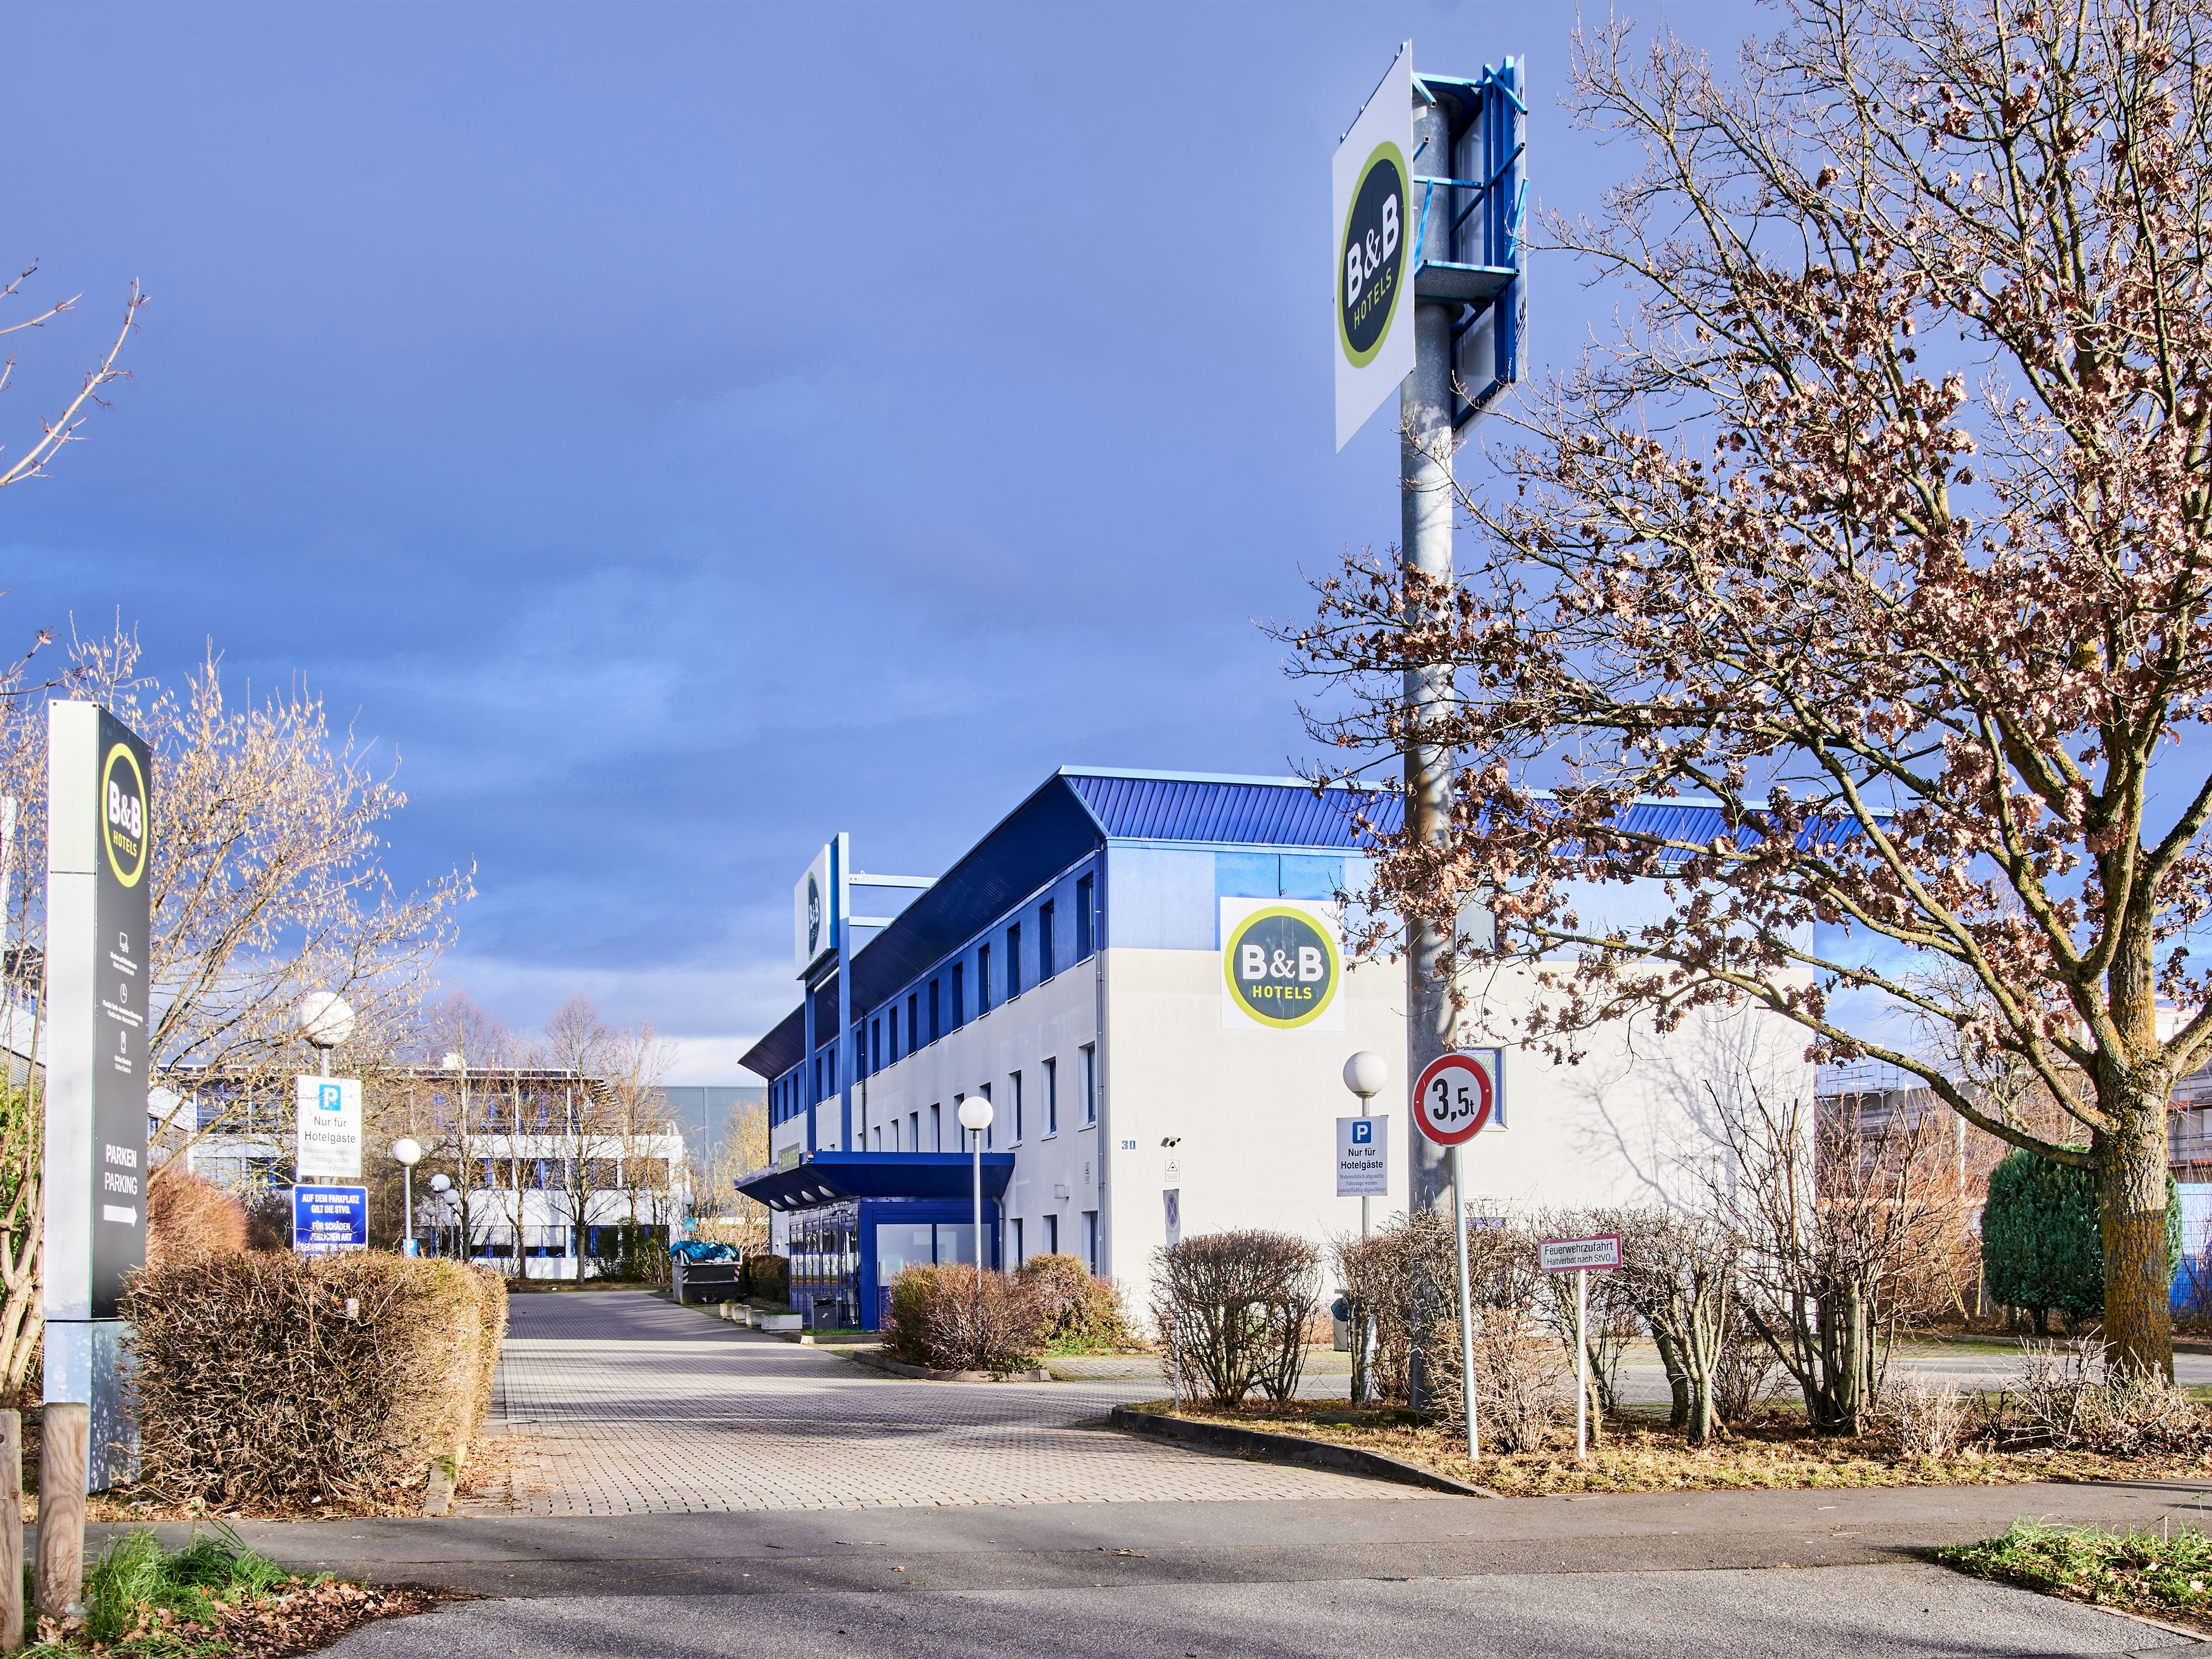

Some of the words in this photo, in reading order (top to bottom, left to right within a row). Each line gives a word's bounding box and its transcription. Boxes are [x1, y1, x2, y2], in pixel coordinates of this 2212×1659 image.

[1348, 194, 1399, 309] B&B
[1354, 268, 1391, 330] HOTELS
[109, 780, 142, 839] B&B
[113, 830, 137, 857] HOTELS
[810, 897, 819, 930] B&B
[1243, 945, 1323, 982] B&B
[1253, 985, 1312, 999] HOTELS
[324, 1087, 338, 1107] P
[314, 1116, 331, 1126] Nur
[334, 1118, 347, 1128] für
[305, 1130, 356, 1144] Hotelgäste
[1357, 1125, 1368, 1140] P
[1121, 1140, 1136, 1150] 30
[1365, 1147, 1376, 1156] für
[106, 1144, 137, 1168] PARKEN
[1341, 1160, 1383, 1170] Hotelgäste
[105, 1172, 137, 1195] PARKING
[302, 1194, 314, 1202] AUF
[315, 1194, 327, 1203] DEM
[328, 1195, 359, 1204] PARKPLATZ
[311, 1204, 324, 1213] GILT
[325, 1205, 334, 1213] DIE
[335, 1206, 351, 1214] STVO.
[312, 1220, 324, 1230] FÜR
[325, 1221, 350, 1231] SCHÄDEN
[341, 1233, 352, 1241] ART
[1545, 1241, 1613, 1255] Feuerwehrzufahrt
[1547, 1256, 1576, 1265] Haltverbot
[1594, 1254, 1610, 1262] StVO
